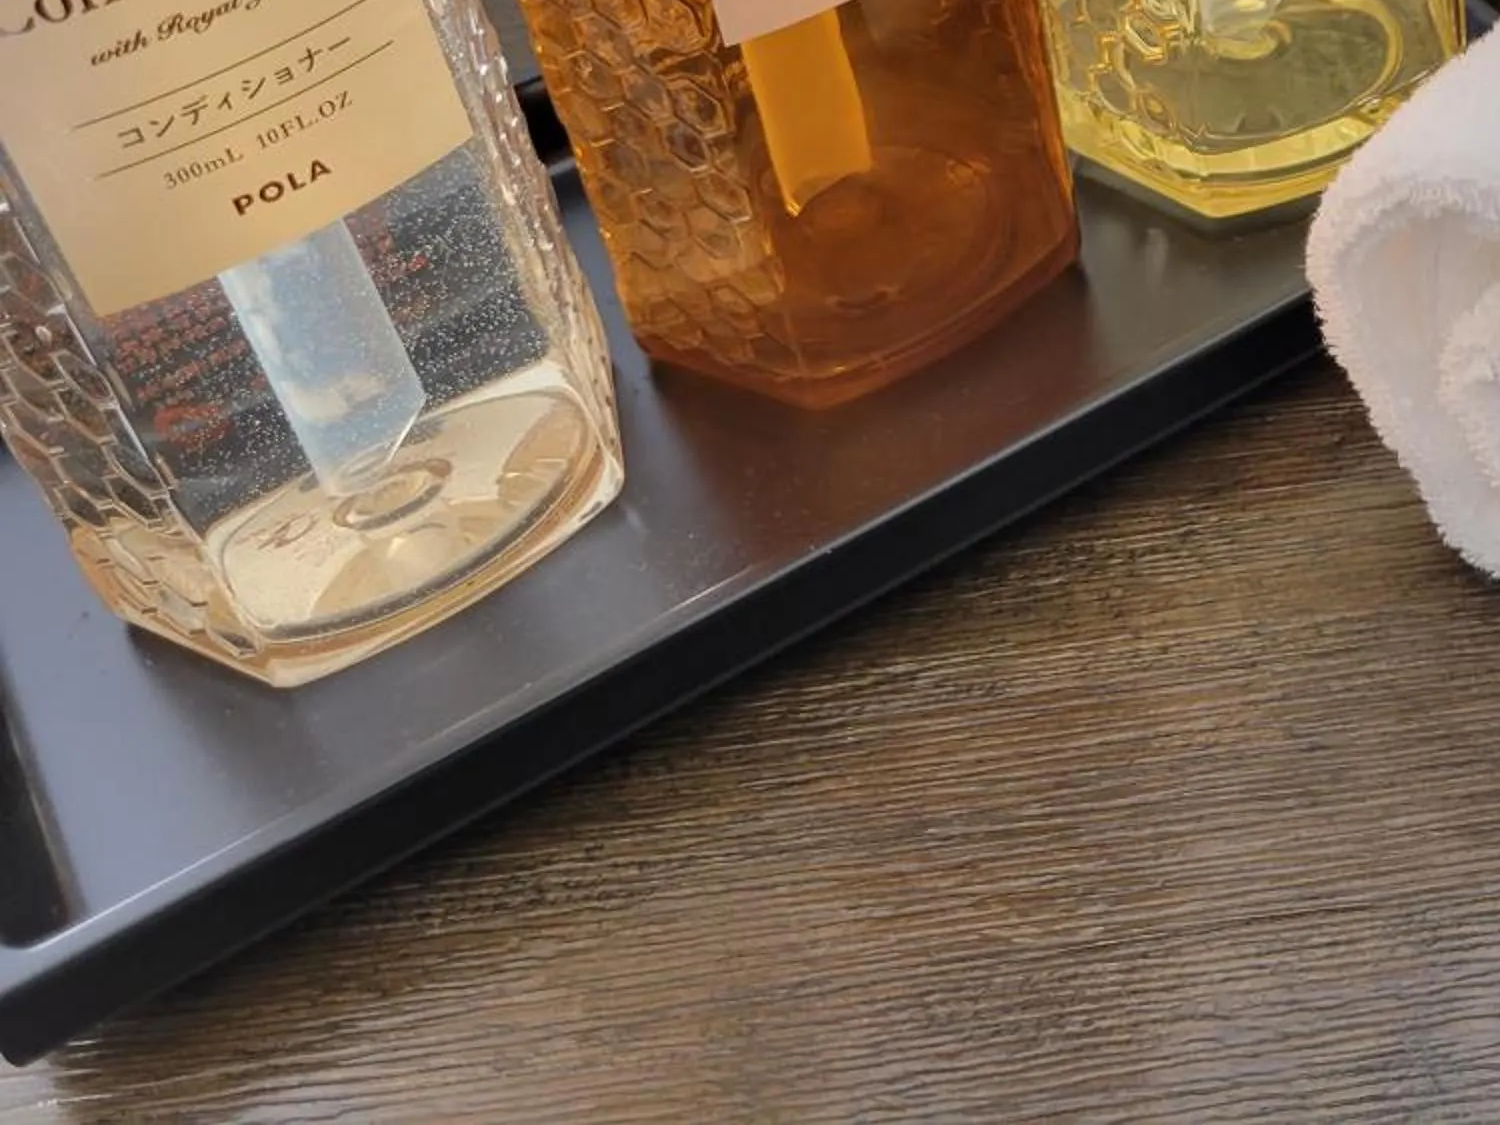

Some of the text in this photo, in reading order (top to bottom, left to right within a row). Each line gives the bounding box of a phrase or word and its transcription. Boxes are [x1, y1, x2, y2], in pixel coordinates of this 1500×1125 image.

[90, 31, 151, 67] with
[117, 36, 351, 150] コンディショナー
[164, 147, 245, 191] 300mL
[232, 159, 333, 216] POLA
